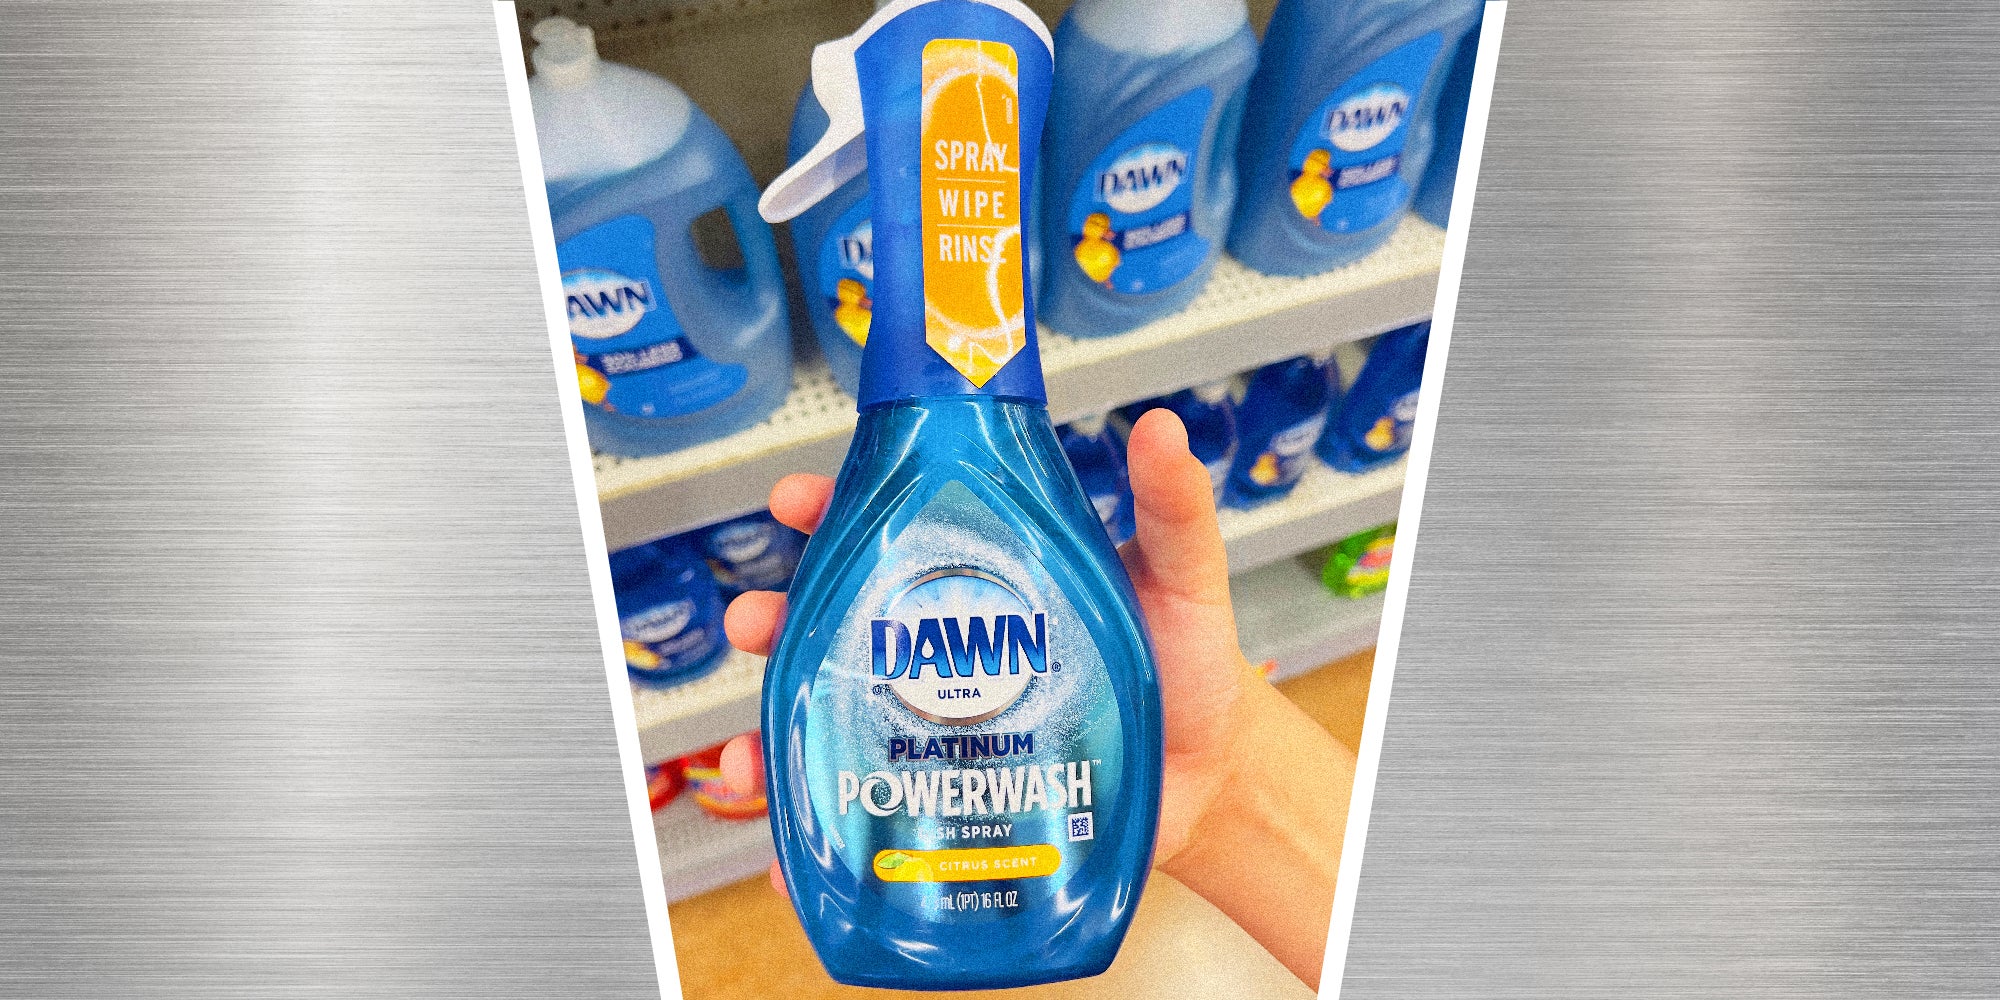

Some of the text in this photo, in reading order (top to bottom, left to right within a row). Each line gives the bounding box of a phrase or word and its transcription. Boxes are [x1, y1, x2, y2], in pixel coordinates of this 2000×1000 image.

[935, 139, 1008, 173] SPRAY
[938, 188, 1005, 219] WIPE
[938, 233, 1007, 263] RINSE
[567, 281, 653, 319] AWN
[870, 612, 1048, 681] DAWN
[937, 687, 981, 700] ULTRA
[889, 733, 1034, 761] PLATINUM
[838, 759, 1093, 817] POWERWASH
[918, 824, 1012, 841] DSH SPRAY
[939, 856, 1038, 872] CITRUS SCENT
[956, 891, 979, 911] (1PT)
[981, 892, 991, 908] 16
[994, 892, 1004, 908] FL
[1005, 891, 1018, 907] OZ
